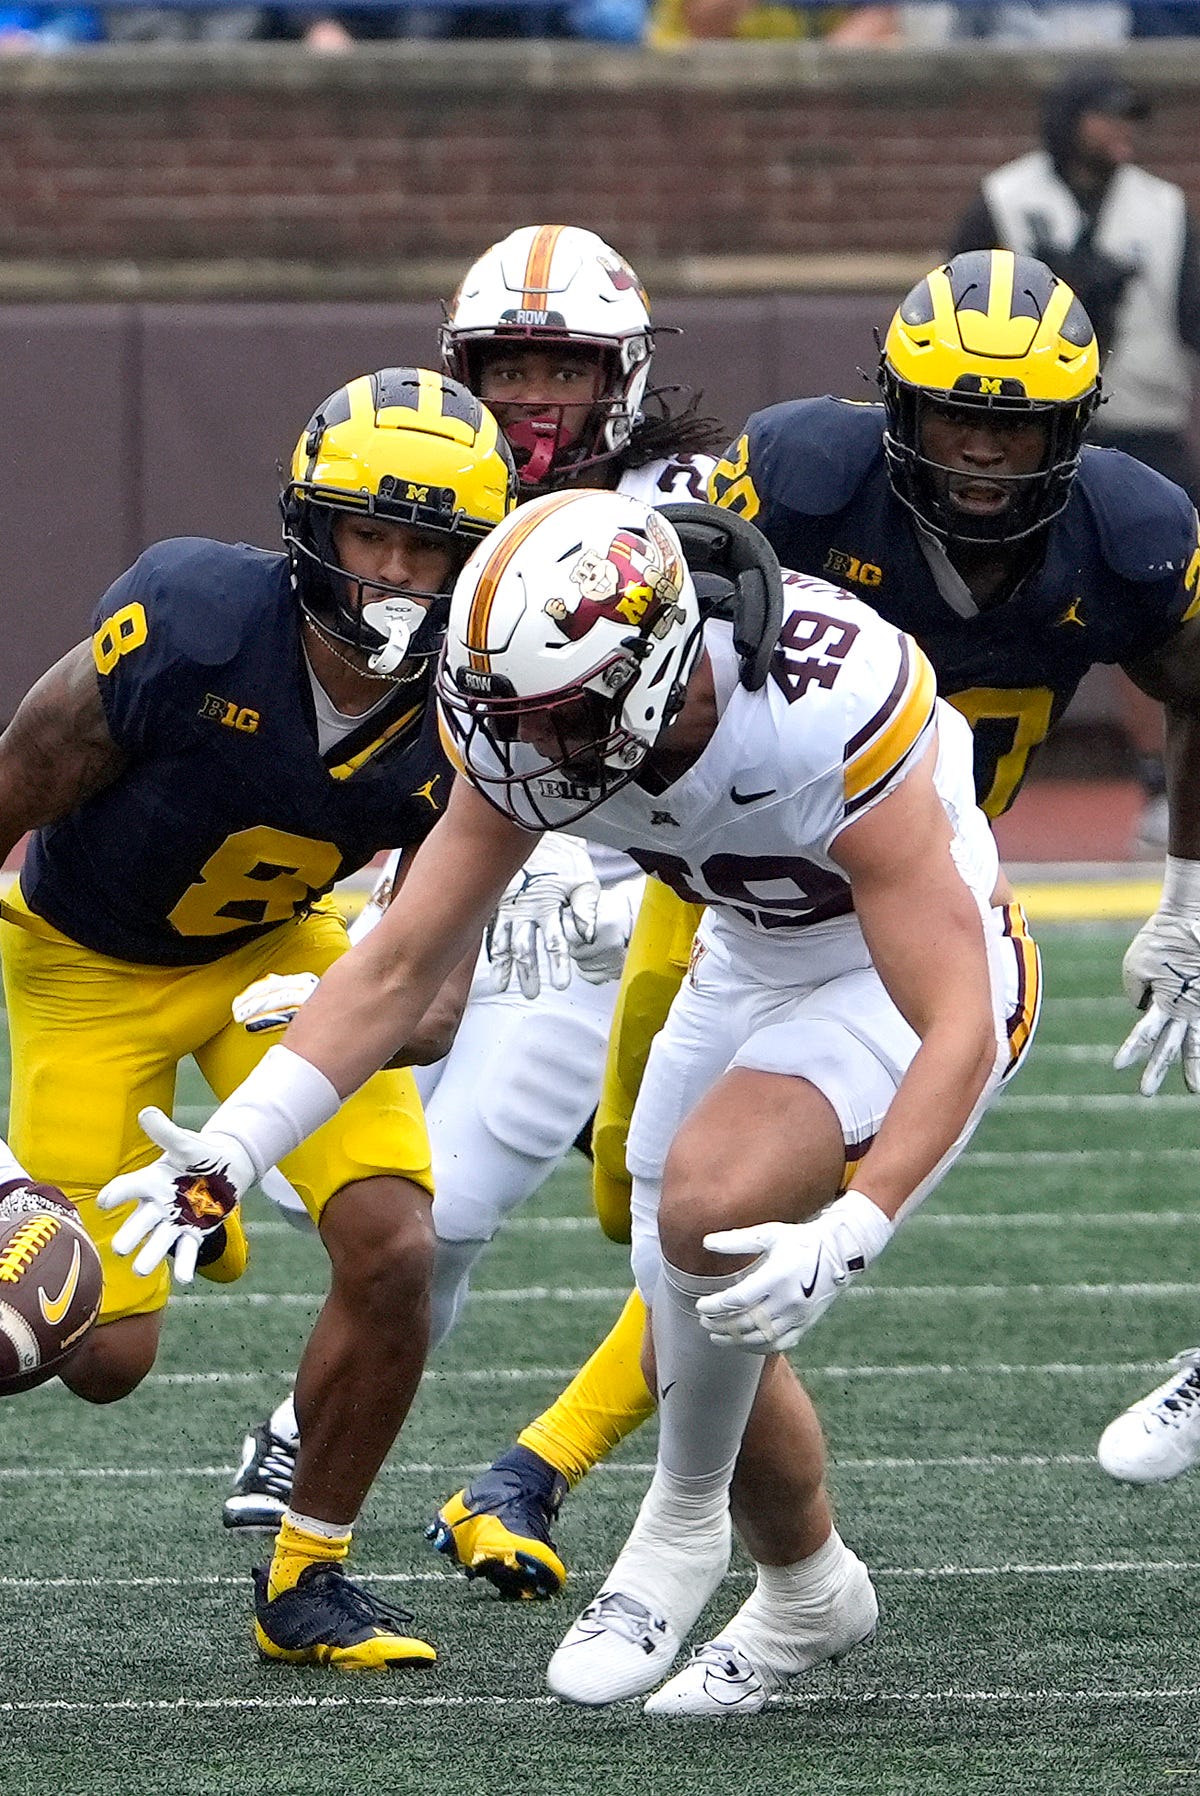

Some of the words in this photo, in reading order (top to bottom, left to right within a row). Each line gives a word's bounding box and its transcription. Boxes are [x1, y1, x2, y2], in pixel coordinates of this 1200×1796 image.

[517, 310, 548, 325] ROW
[980, 377, 1002, 395] M
[406, 484, 429, 502] M
[92, 601, 148, 676] 8
[768, 609, 861, 706] 49
[166, 825, 343, 936] 8
